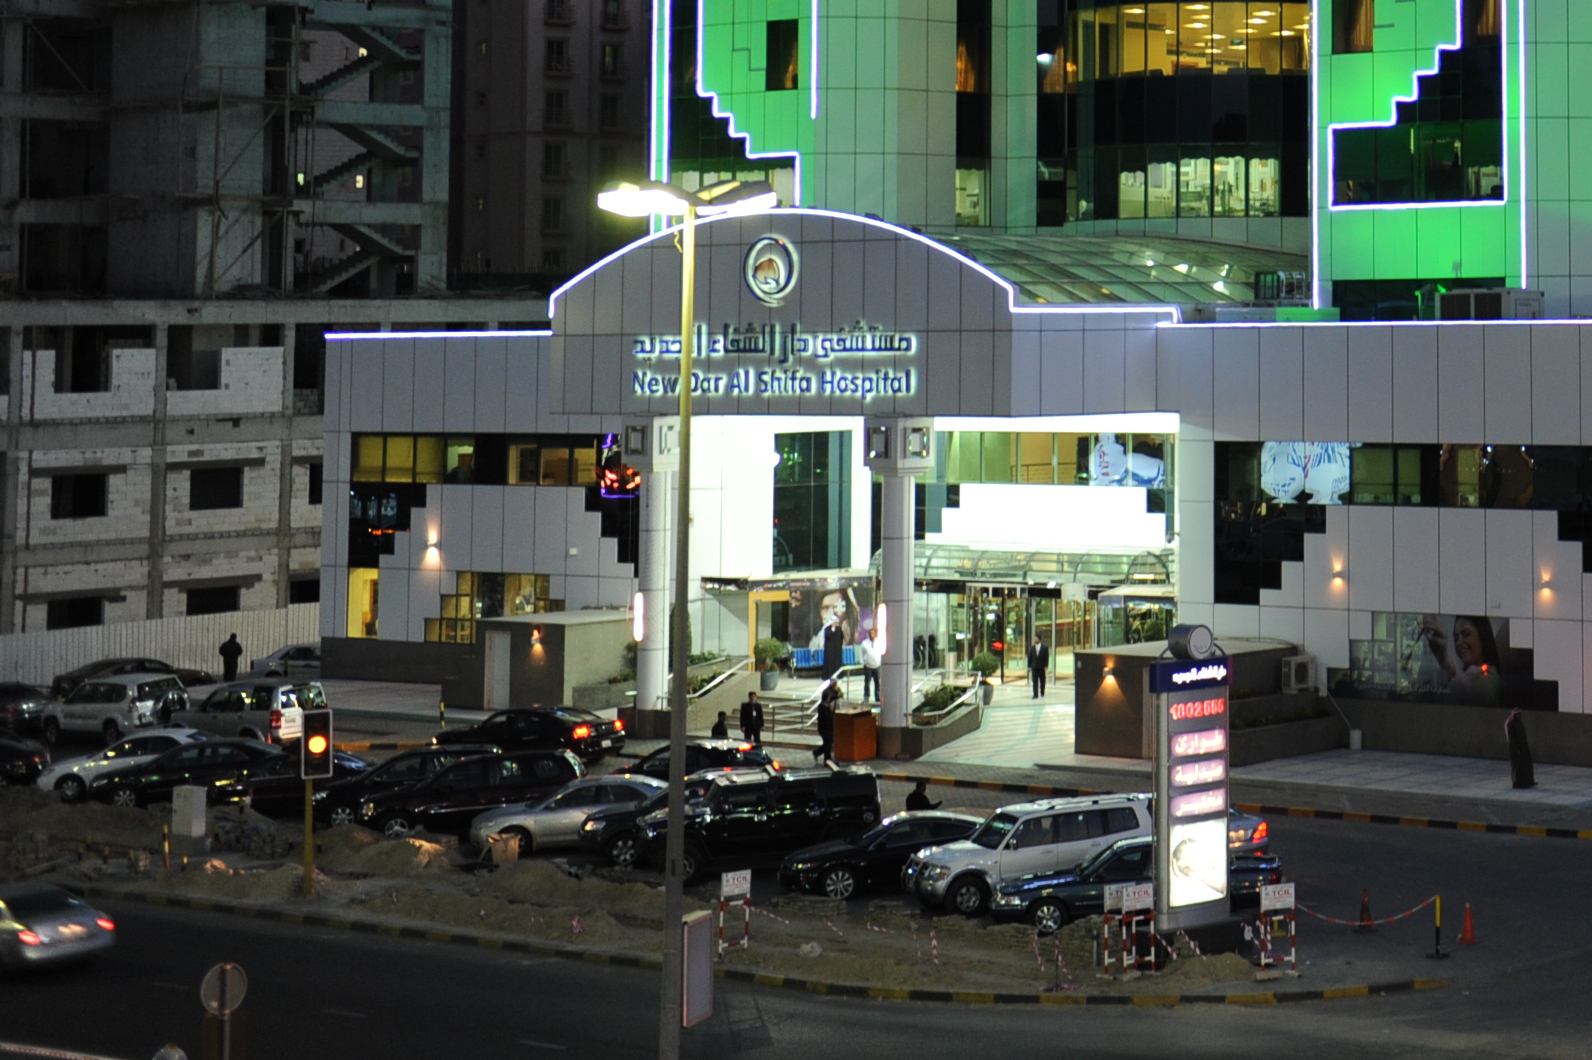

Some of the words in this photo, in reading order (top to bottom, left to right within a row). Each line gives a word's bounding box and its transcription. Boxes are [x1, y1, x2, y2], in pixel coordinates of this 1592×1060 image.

[631, 324, 704, 362] اجديد
[708, 321, 777, 357] الشفاء
[777, 323, 812, 364] دار
[813, 319, 914, 359] مستشفى
[631, 370, 680, 395] New
[729, 368, 754, 395] Al
[757, 368, 814, 395] Shifa
[820, 369, 914, 400] Hospital
[1169, 697, 1225, 720] 1802555
[1175, 729, 1223, 755] طوارئ
[1175, 763, 1223, 785] صيدلية
[1175, 791, 1223, 817] مختبر
